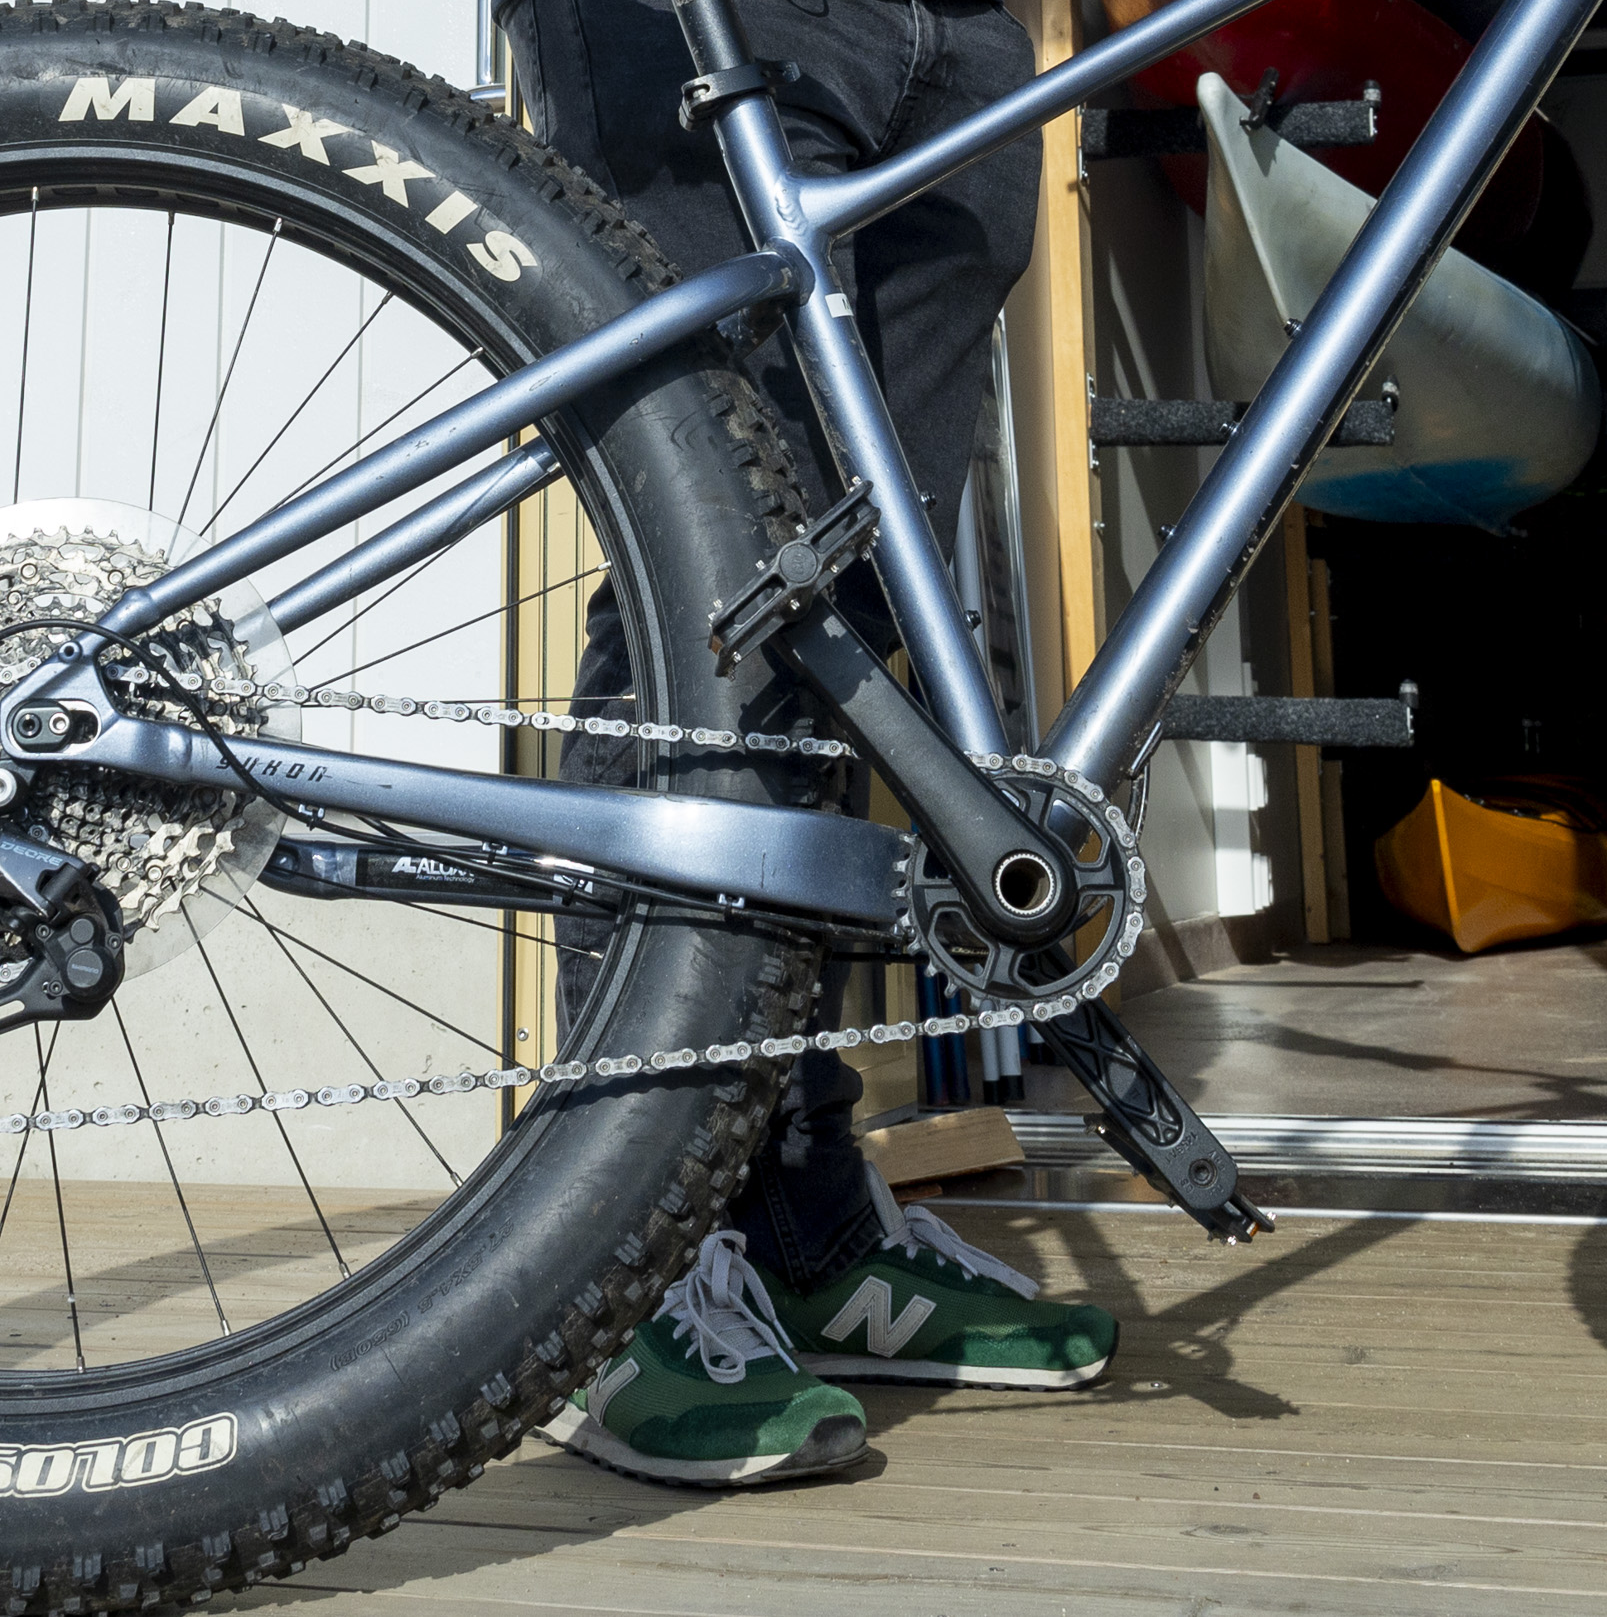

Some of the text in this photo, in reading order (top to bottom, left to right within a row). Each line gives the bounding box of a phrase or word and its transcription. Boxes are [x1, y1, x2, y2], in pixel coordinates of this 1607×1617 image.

[58, 77, 540, 282] MAXXIS
[0, 841, 64, 866] DEORE
[820, 1275, 937, 1358] N
